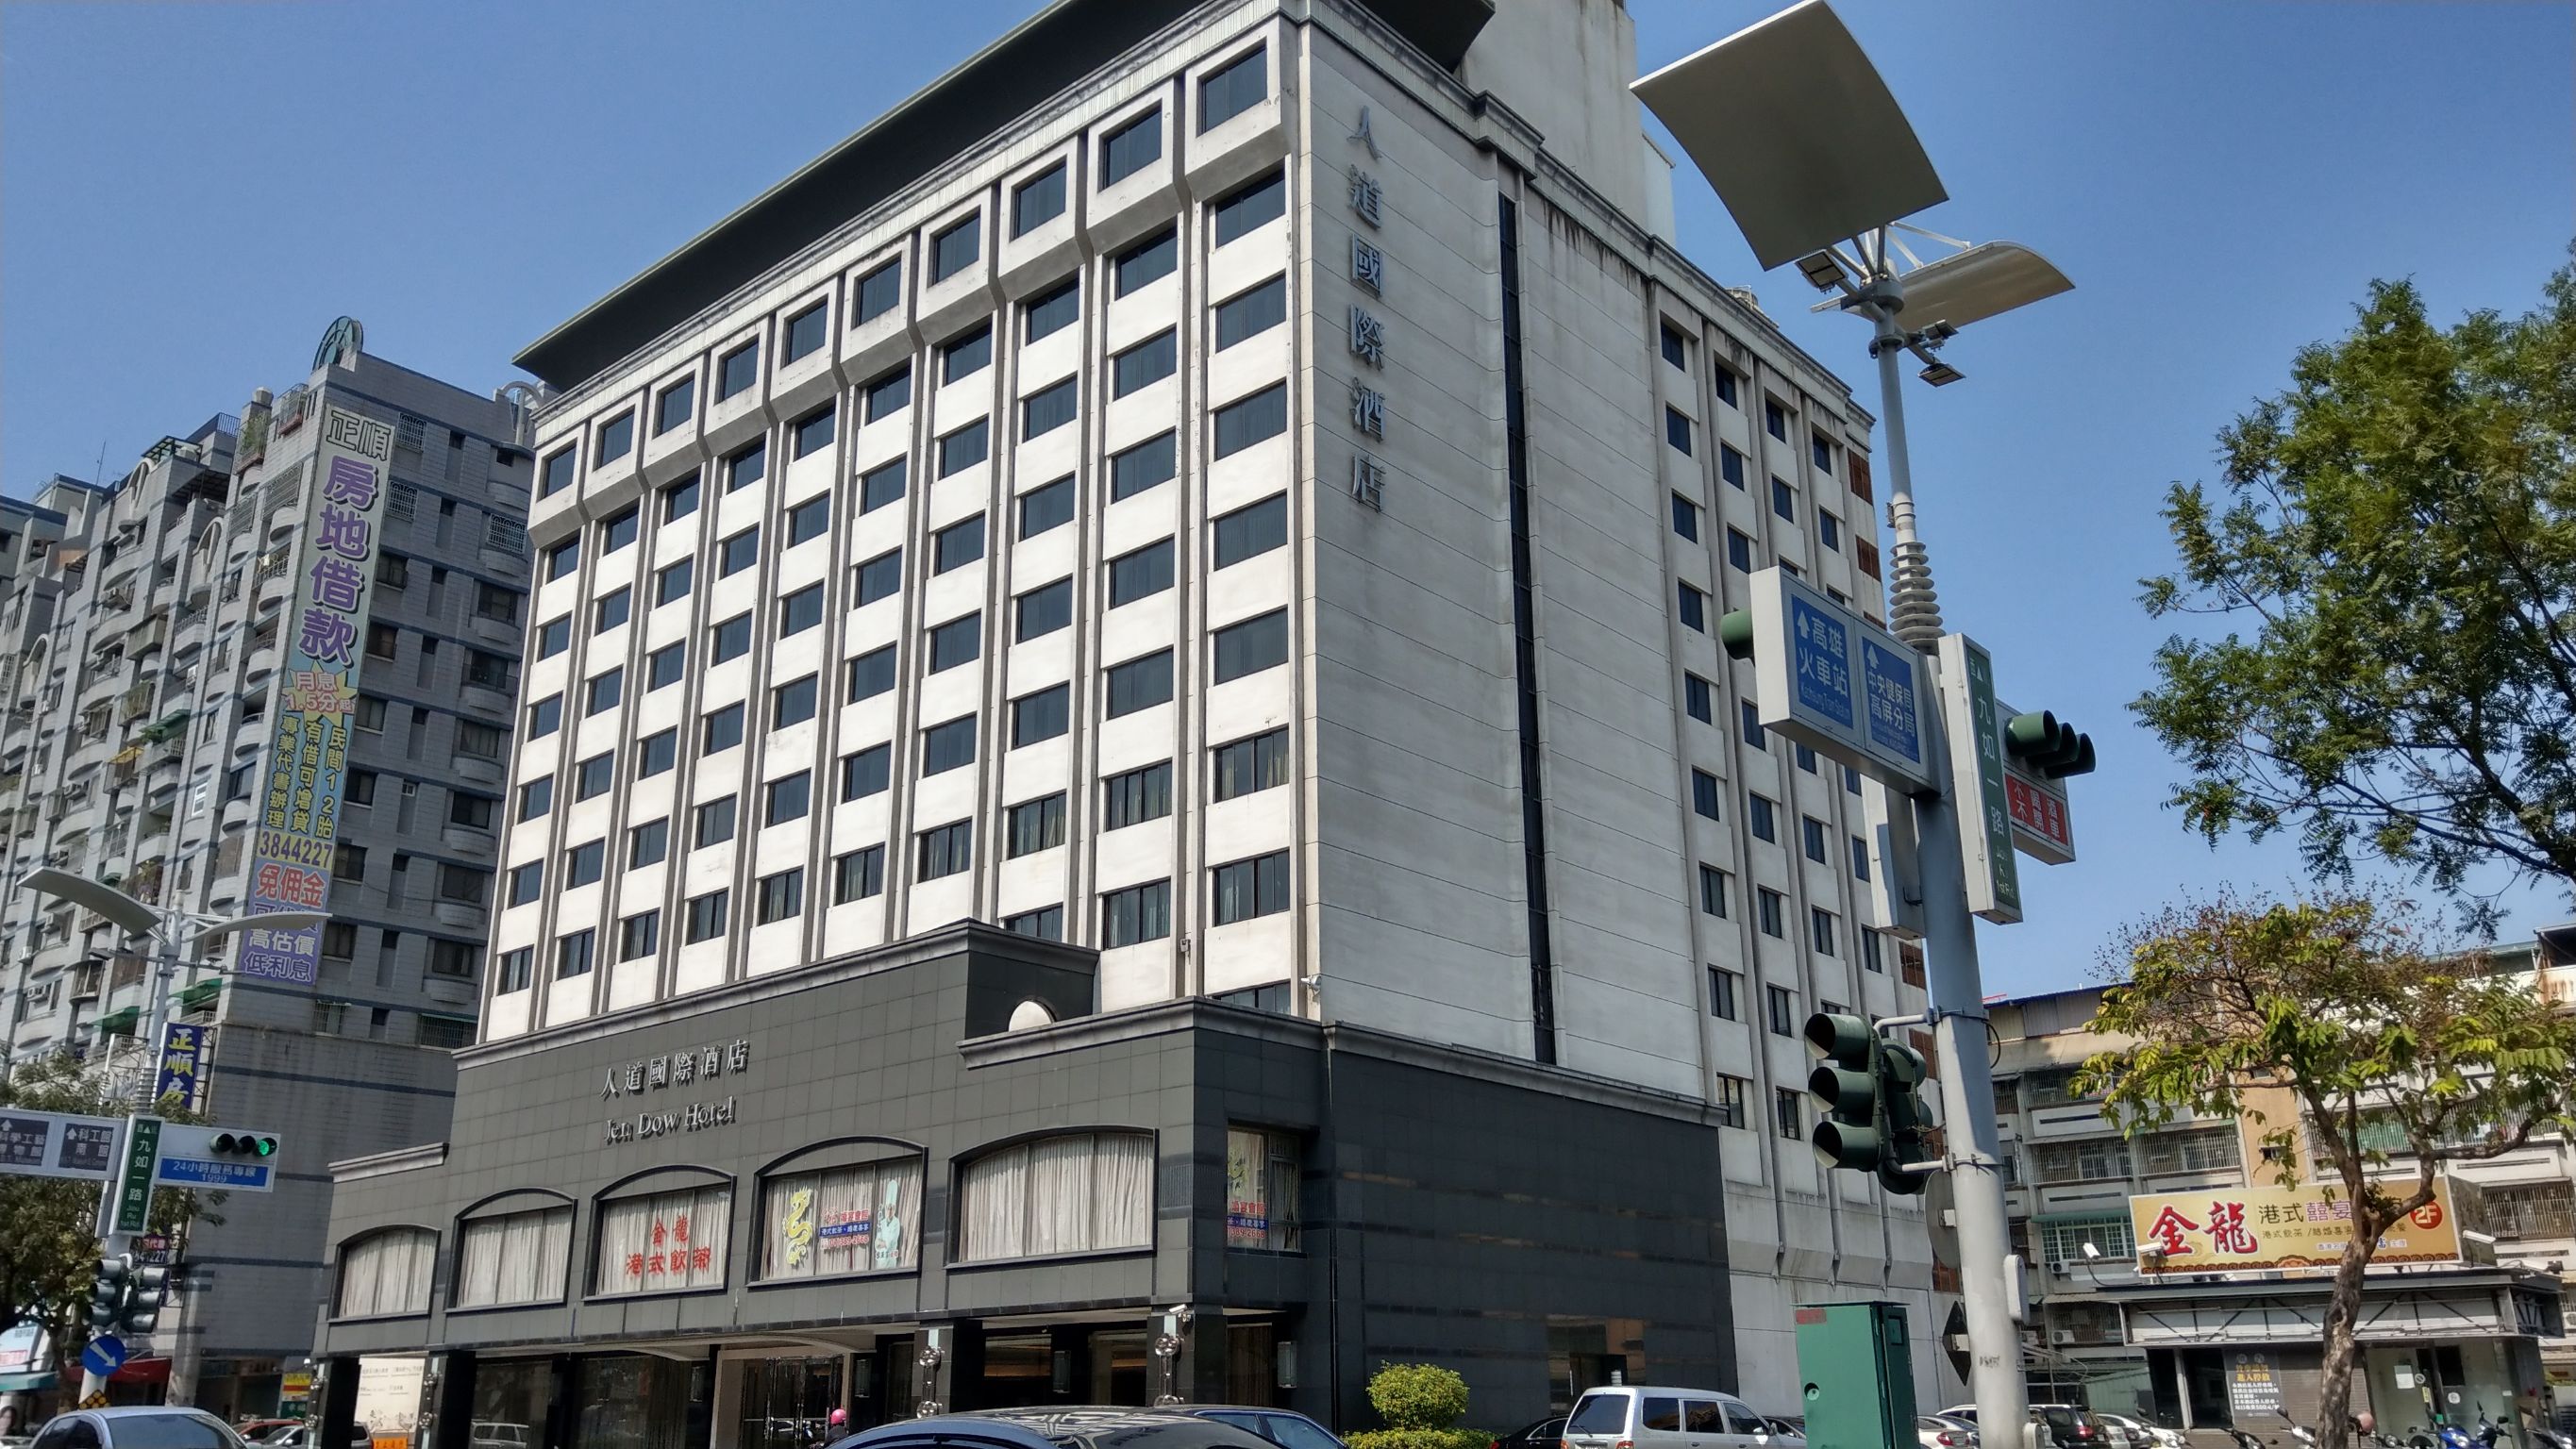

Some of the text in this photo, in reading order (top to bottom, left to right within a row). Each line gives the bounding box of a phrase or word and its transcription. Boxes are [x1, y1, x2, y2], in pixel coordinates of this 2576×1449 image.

[1347, 105, 1384, 513] 人道國際酒店
[326, 410, 391, 461] 正順
[299, 455, 378, 668] 房地借款
[1811, 616, 1844, 658] 高雄
[295, 672, 338, 691] 月息
[1798, 647, 1848, 697] 火車站
[1866, 669, 1913, 712] 中央健保局
[1870, 692, 1915, 738] 高屏分局
[1977, 695, 2005, 837] 九如一路
[259, 831, 332, 868] 3844227
[255, 862, 325, 908] 免佣金
[249, 928, 316, 957] 高估價
[244, 952, 311, 982] 低利息
[599, 1040, 748, 1097] 人道國際酒店
[605, 1095, 734, 1142] Jen Dow Hotel
[128, 1139, 151, 1201] 九如一路
[173, 1161, 257, 1177] 24小時服務專線
[201, 1174, 227, 1183] 1999
[651, 1214, 690, 1247] 金龍
[2148, 1201, 2260, 1257] 金龍
[2414, 1205, 2437, 1224] 2F
[626, 1246, 711, 1276] 港式飲茶
